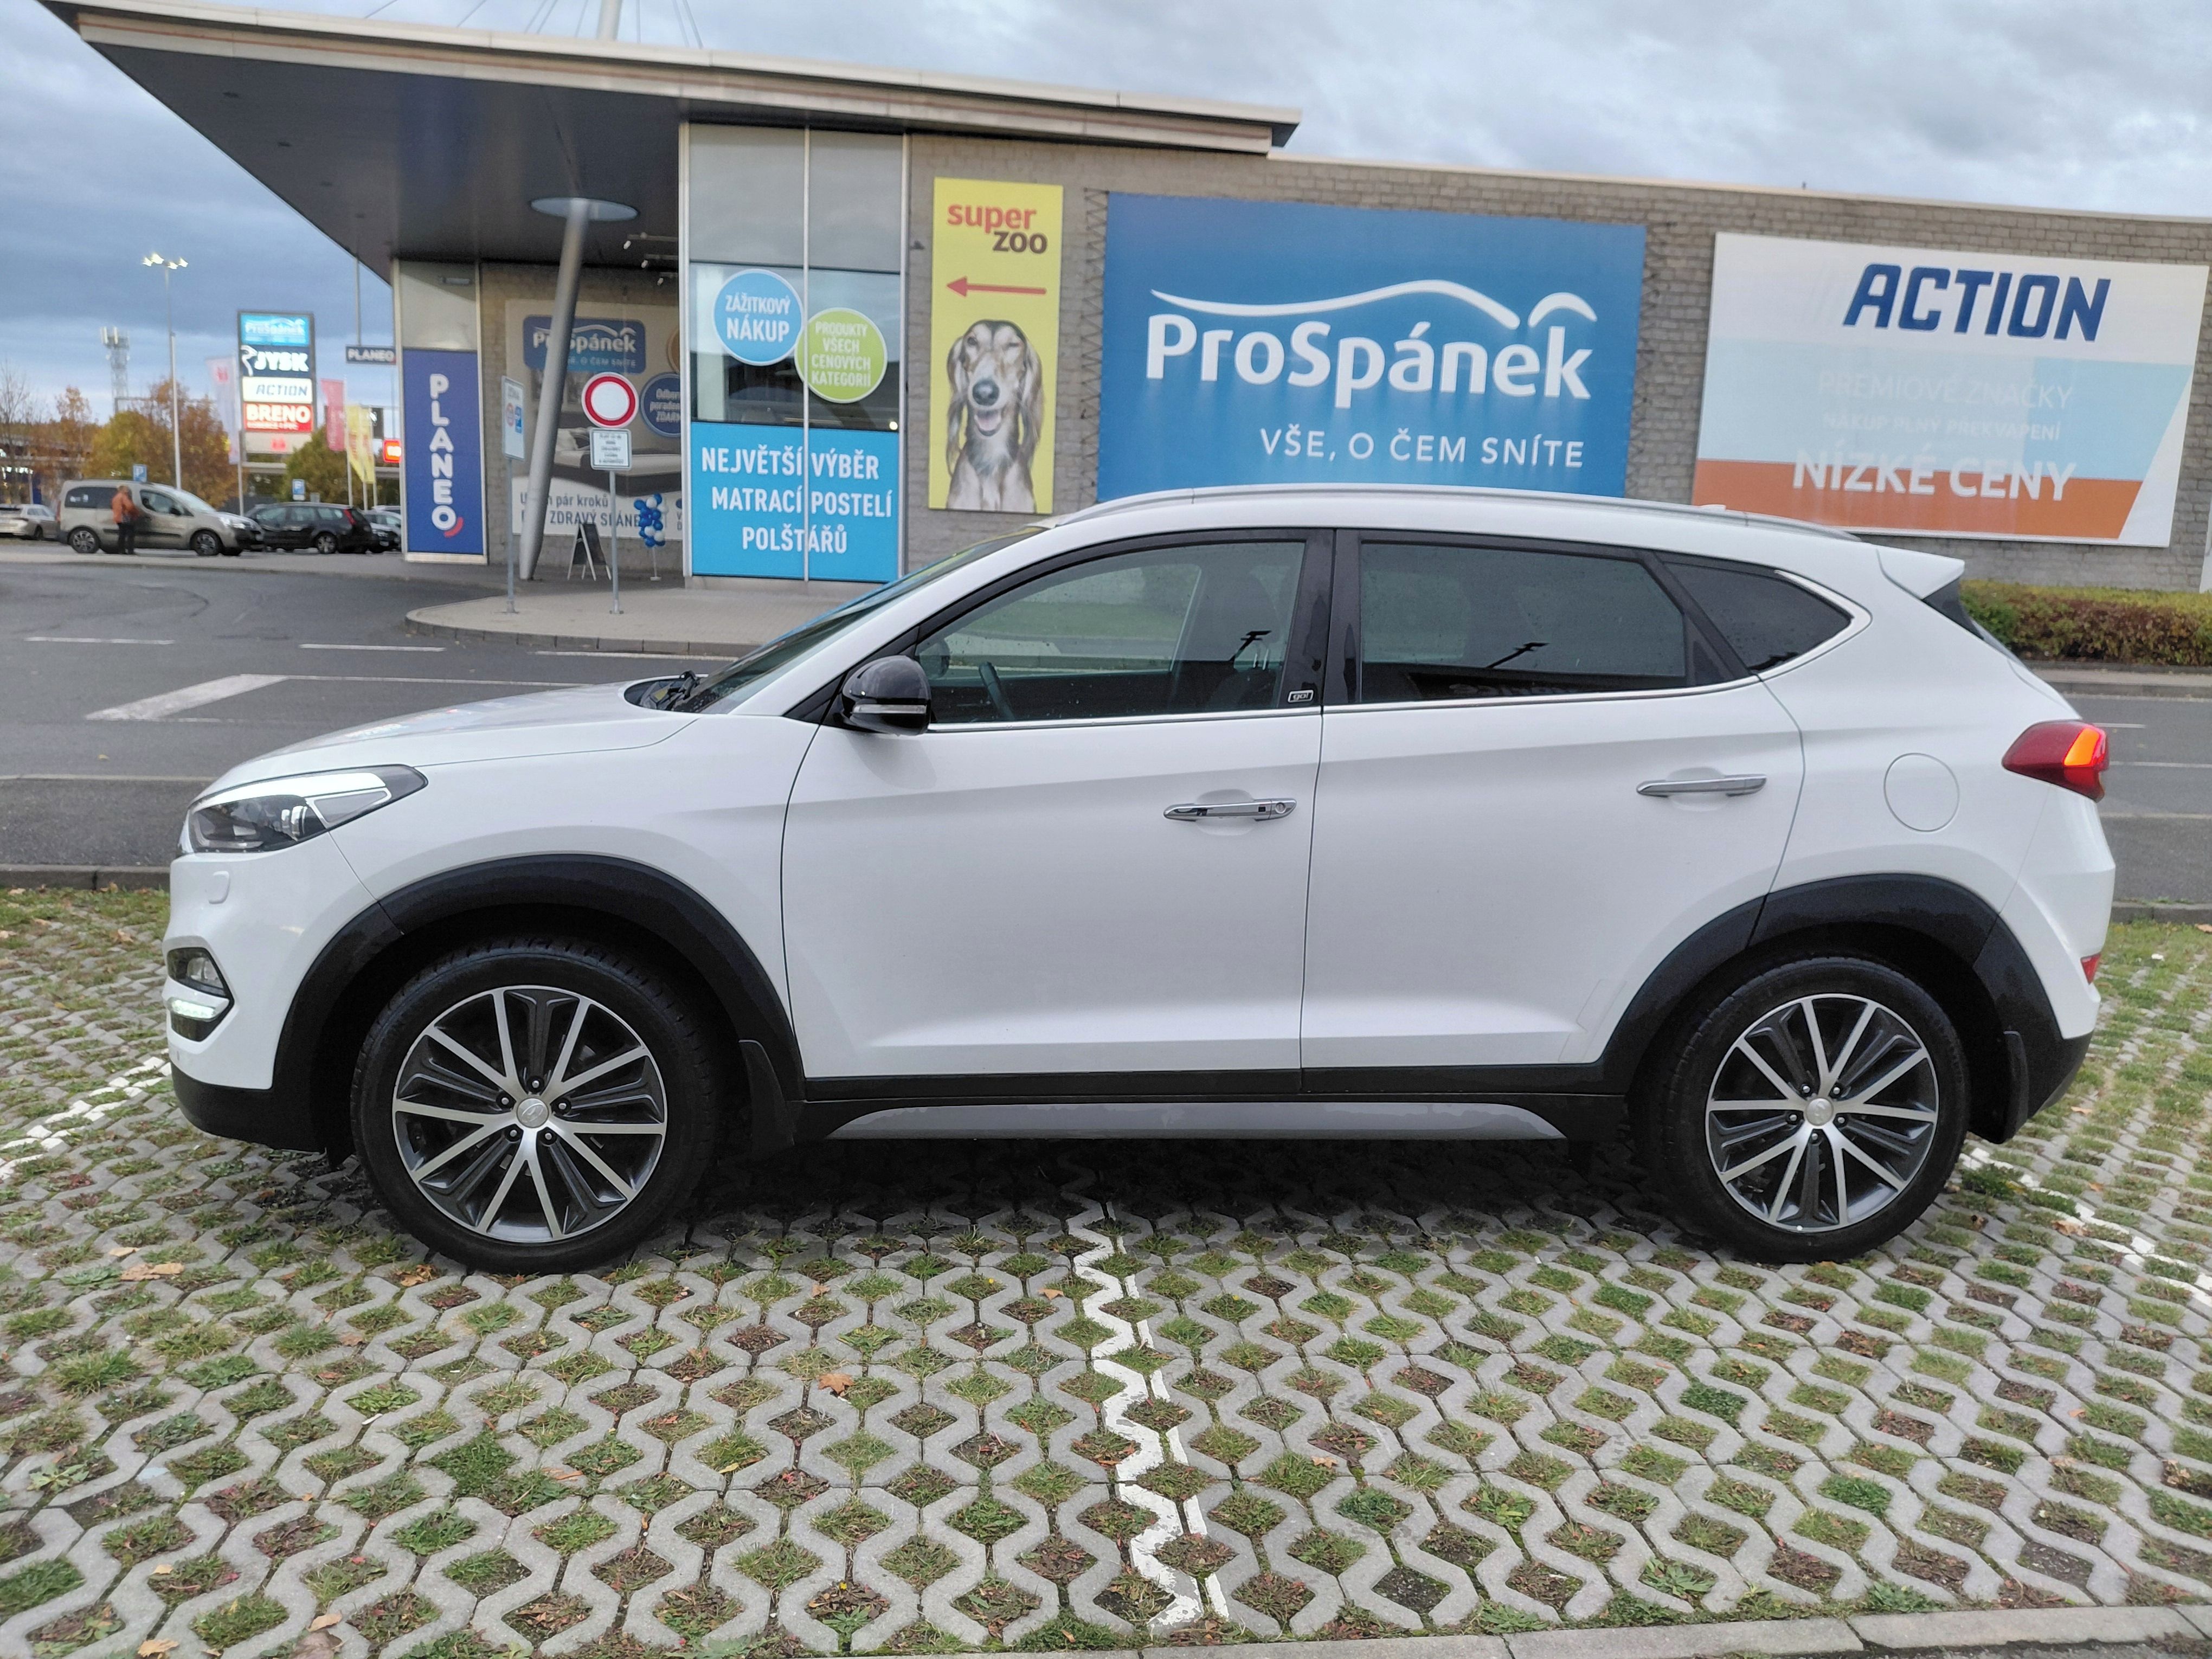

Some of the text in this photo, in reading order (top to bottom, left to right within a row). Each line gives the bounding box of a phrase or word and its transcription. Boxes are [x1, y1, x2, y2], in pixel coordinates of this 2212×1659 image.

[947, 203, 1037, 233] super
[992, 230, 1047, 254] zoo
[725, 292, 790, 315] ZÁŽITKOVÝ
[1843, 262, 2111, 342] ACTION
[726, 313, 789, 343] NÁKUP
[815, 321, 867, 337] PRODUKTY
[533, 332, 636, 354] Ppánek
[822, 335, 860, 354] VŠECH
[254, 351, 309, 372] JYSK
[348, 349, 395, 362] PLANEO
[811, 353, 871, 371] CENOVÝCH
[1146, 313, 1593, 409] ProSpánek
[256, 384, 308, 396] ACTION
[246, 403, 311, 423] BRENO
[429, 374, 456, 531] PLANEO
[1259, 423, 1585, 468] VŠE, O ČEM SNÍTE
[702, 443, 879, 480] NEJVĚTŠÍ VÝBĚR
[1792, 440, 2078, 502] NÍZKÉ CENY
[556, 493, 574, 507] pár
[577, 493, 608, 508] kroků
[712, 485, 892, 518] MATRACÍ POSTELÍ
[550, 509, 640, 528] ZDRAVÝ SÁNE
[742, 523, 847, 554] POLŠTÁŘŮ
